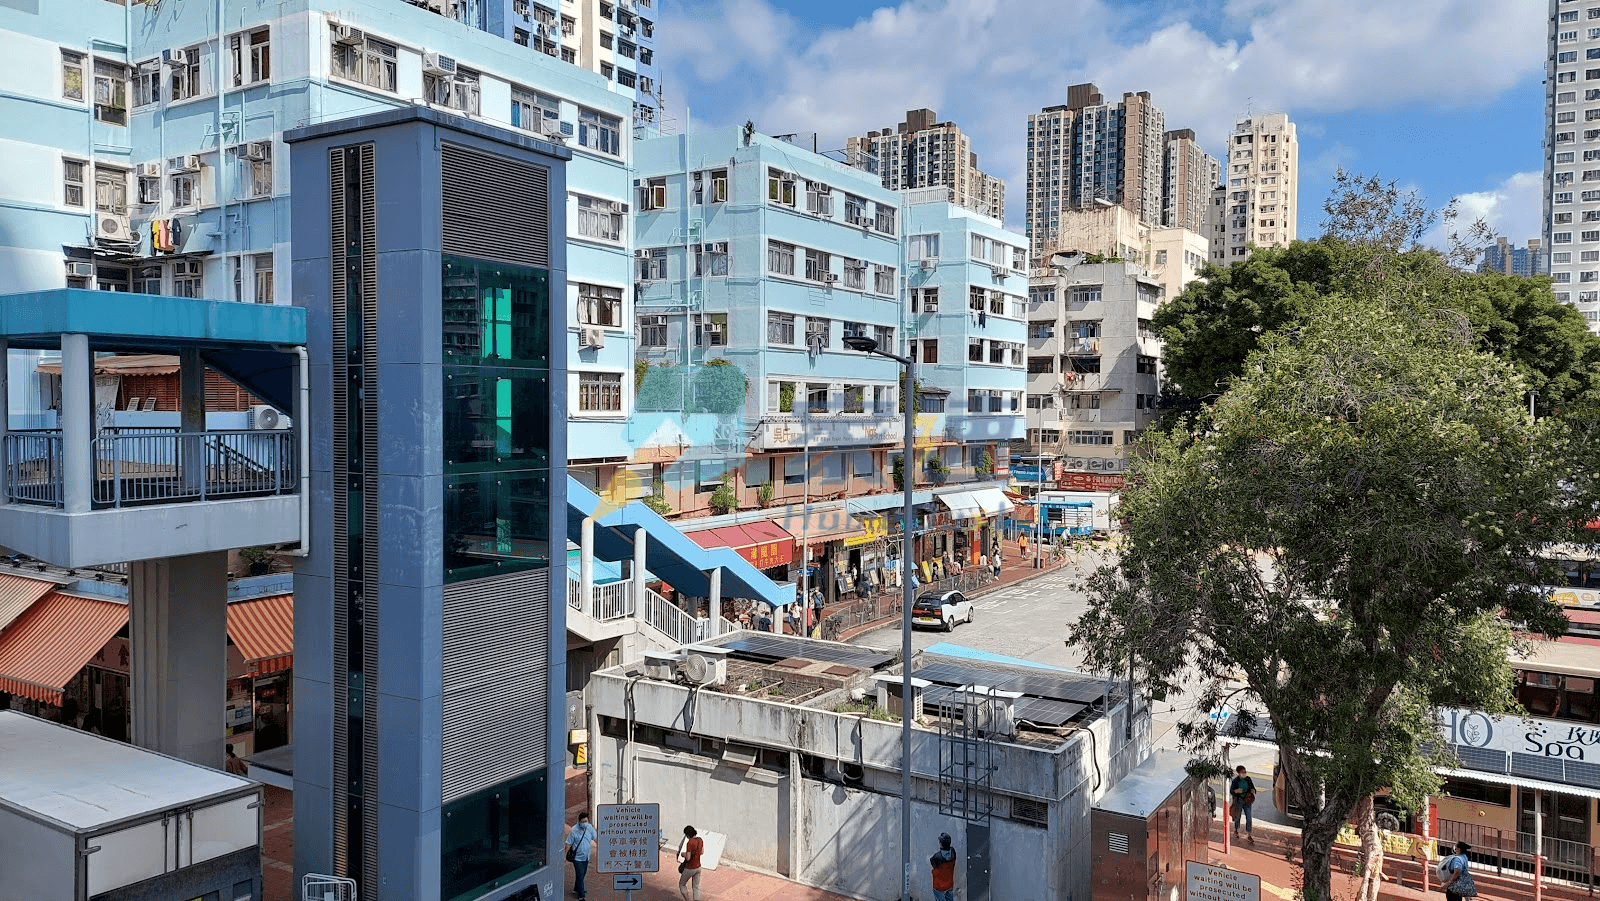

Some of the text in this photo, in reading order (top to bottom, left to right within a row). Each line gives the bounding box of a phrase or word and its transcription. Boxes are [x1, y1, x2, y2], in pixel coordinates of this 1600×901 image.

[1524, 731, 1585, 761] Spa
[1207, 868, 1238, 881] Vehicle
[1193, 874, 1252, 893] waiting will be
[1199, 884, 1246, 900] prosecuted
